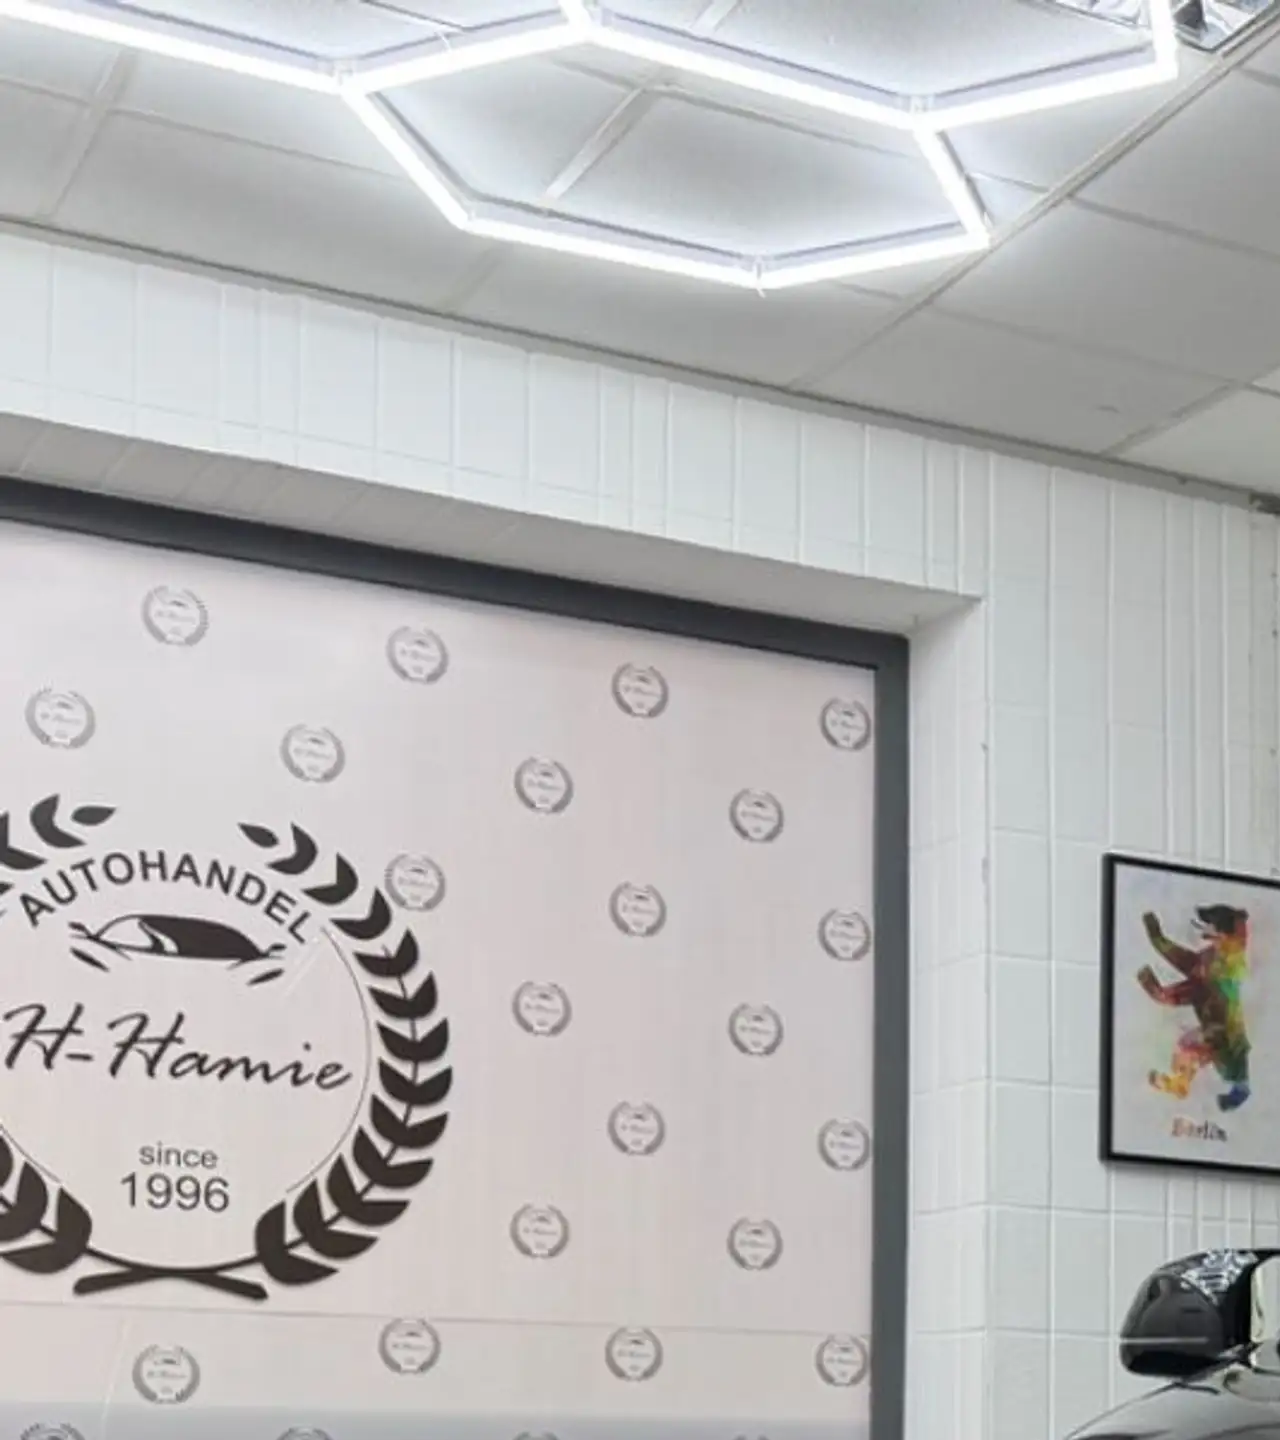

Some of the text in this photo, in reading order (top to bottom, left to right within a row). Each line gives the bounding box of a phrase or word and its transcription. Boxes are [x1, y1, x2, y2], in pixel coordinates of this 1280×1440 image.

[19, 849, 316, 945] AUTOHANDEL
[2, 1002, 354, 1092] H-Hamie
[139, 1141, 219, 1169] since
[120, 1172, 231, 1213] 1996
